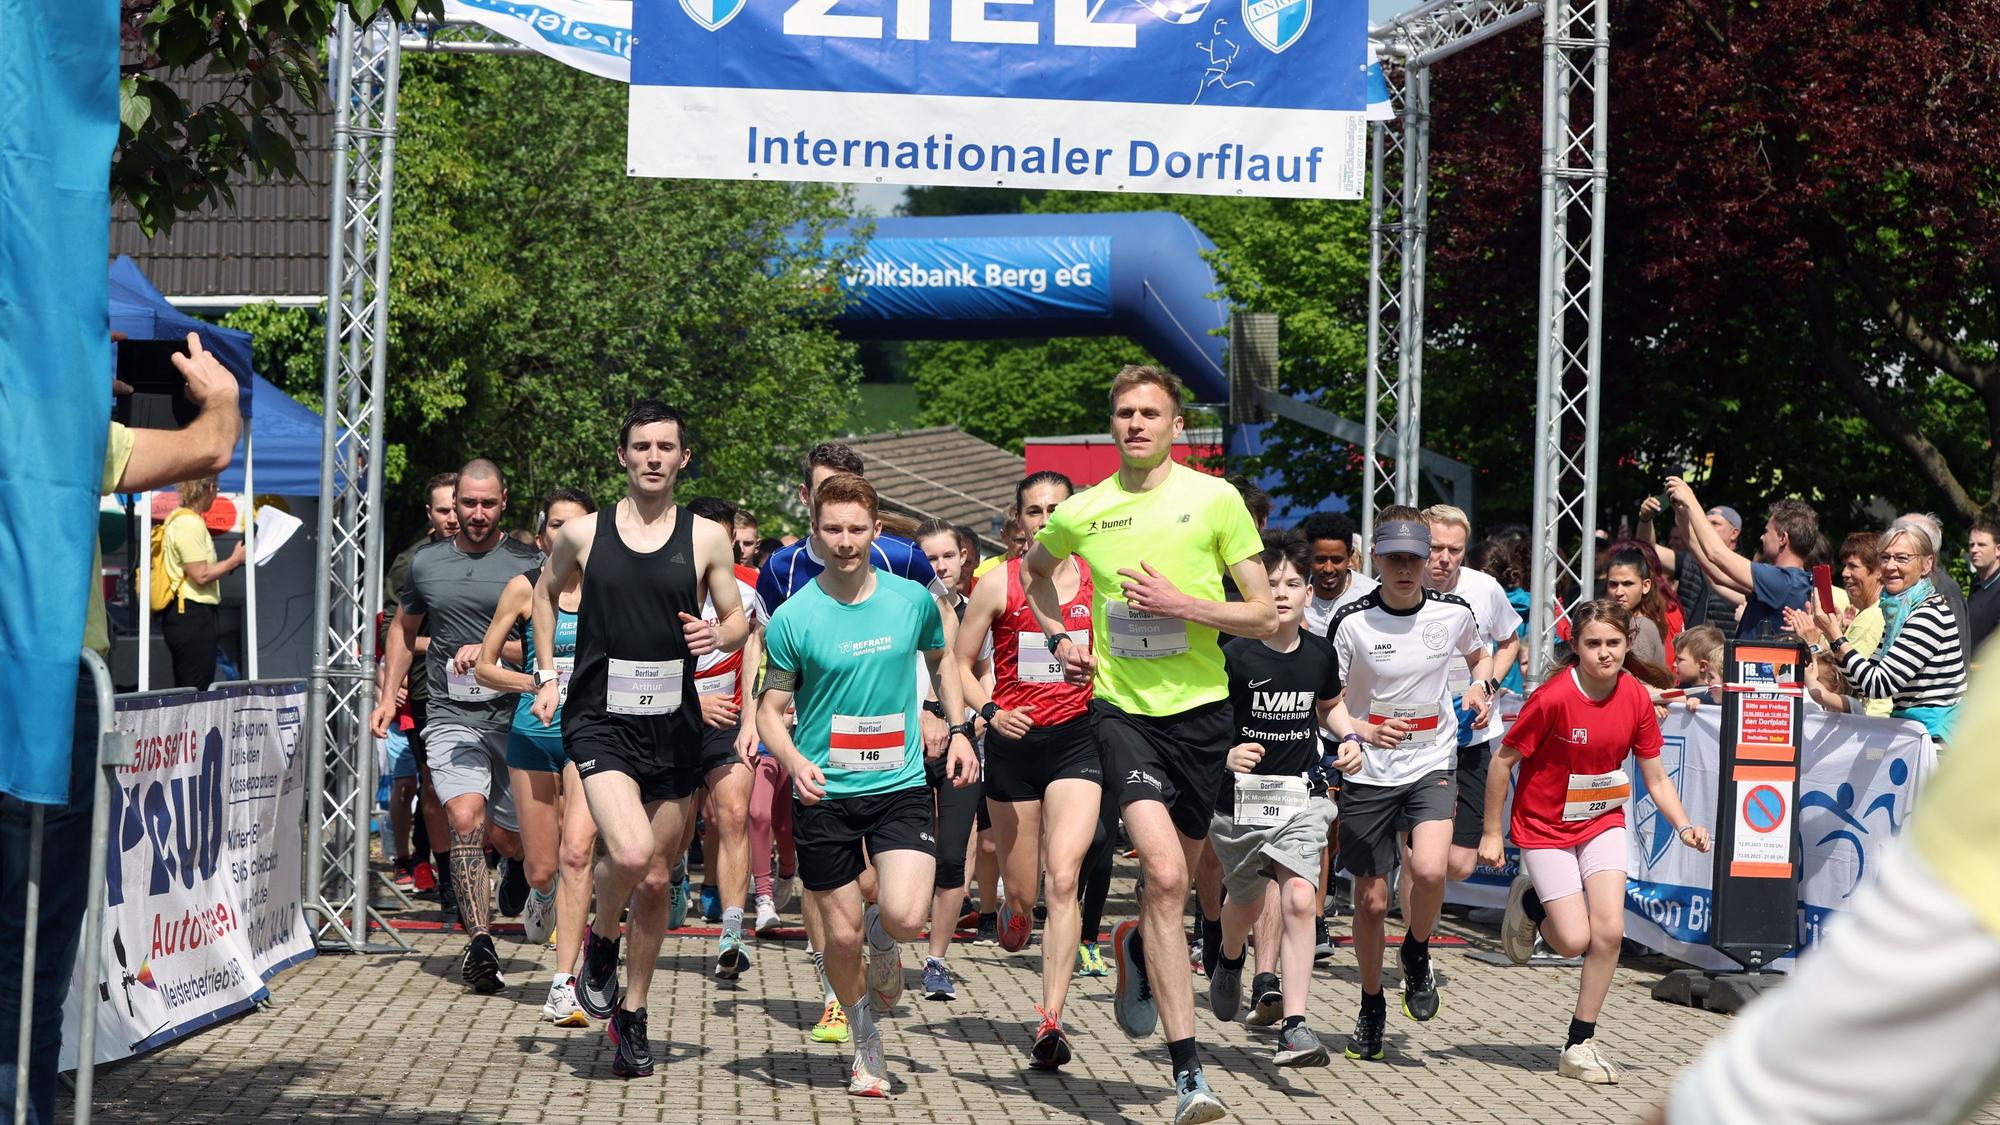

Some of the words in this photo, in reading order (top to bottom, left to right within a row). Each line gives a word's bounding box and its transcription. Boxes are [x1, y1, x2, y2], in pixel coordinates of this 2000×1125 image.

[747, 127, 1112, 177] Internationaler
[1128, 140, 1323, 183] Dorflauf
[844, 262, 978, 288] Volksbank
[985, 263, 1047, 292] Berg
[1055, 263, 1092, 287] eG
[1101, 517, 1133, 530] bunert
[1128, 623, 1160, 633] Simon
[852, 636, 892, 650] REFRATH
[1141, 637, 1148, 648] 1
[635, 669, 660, 677] Dorflauf
[1048, 664, 1061, 673] 53
[1744, 663, 1759, 677] 16.
[469, 686, 481, 695] 22
[632, 681, 663, 691] Arthur
[639, 695, 654, 705] 27
[1252, 691, 1299, 712] LVM
[1768, 703, 1788, 711] Freitag
[1758, 718, 1788, 726] Dorfplatz
[858, 724, 883, 733] Dorflauf
[1241, 726, 1311, 742] Sommerbeg
[859, 750, 880, 761] 146
[1260, 782, 1284, 790] Dorflauf
[1591, 780, 1612, 788] Dorflauf
[1262, 805, 1280, 817] 301
[1588, 801, 1607, 812] 228
[1687, 895, 1713, 933] Bi
